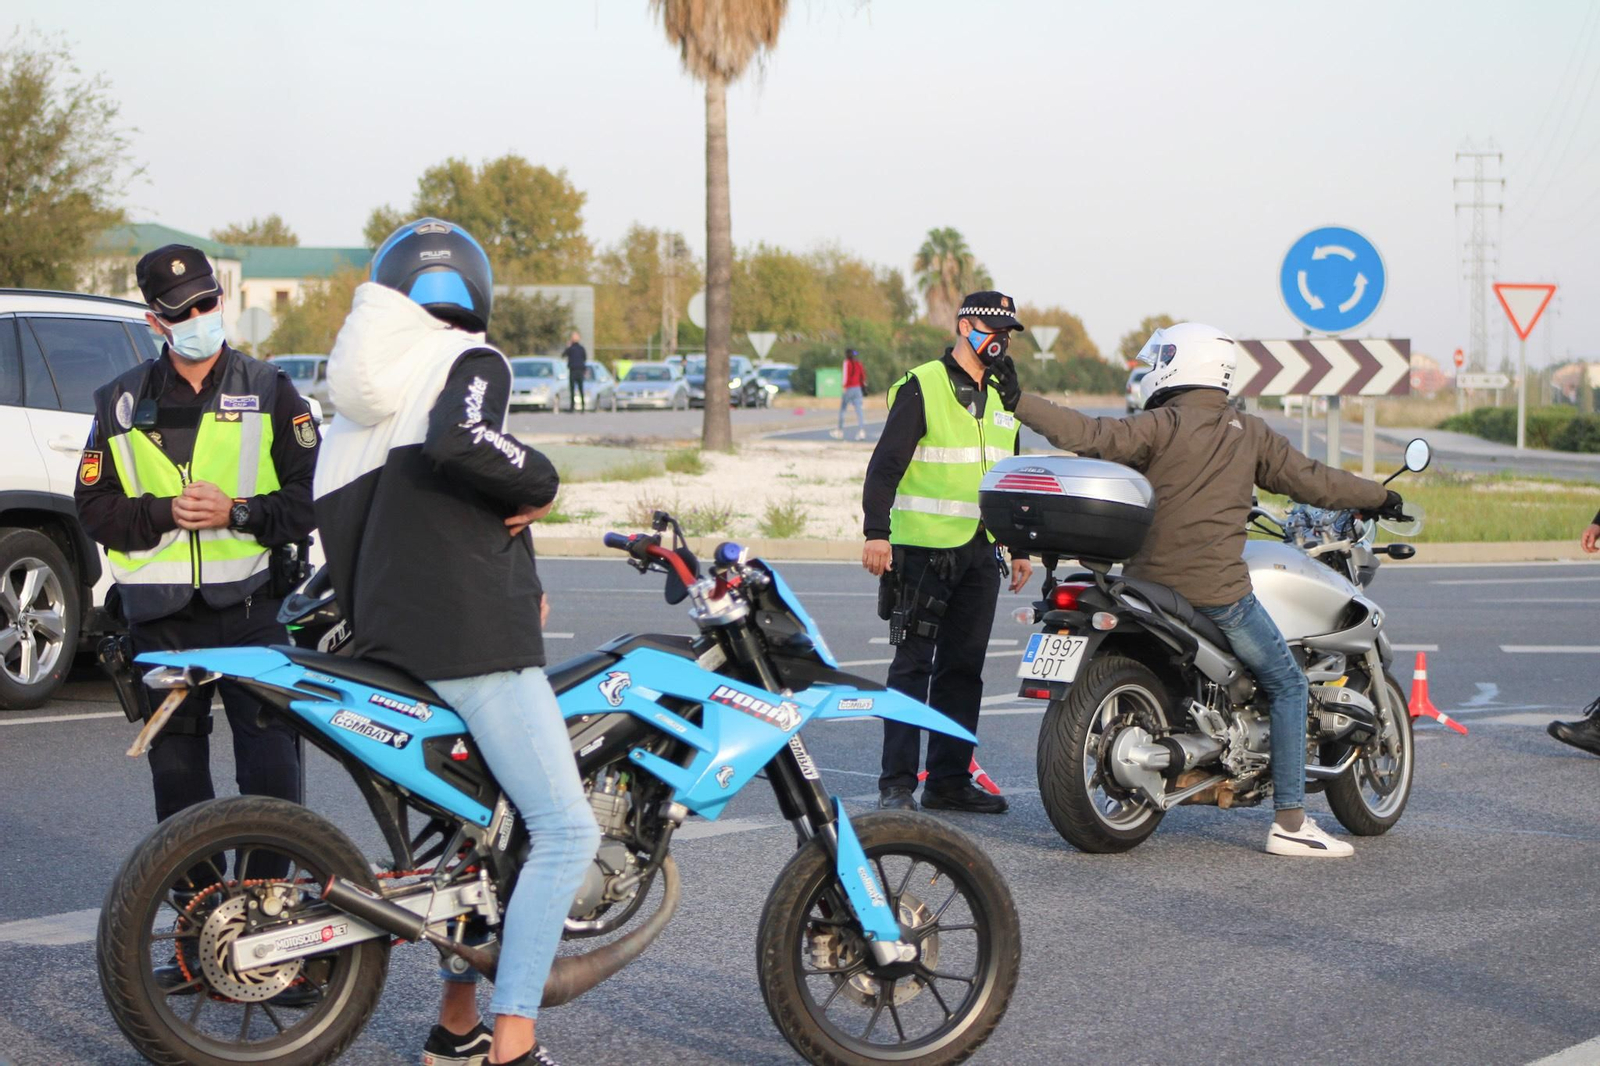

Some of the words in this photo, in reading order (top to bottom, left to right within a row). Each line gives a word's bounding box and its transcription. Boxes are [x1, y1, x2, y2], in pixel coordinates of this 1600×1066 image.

[1041, 638, 1083, 657] 1997
[1031, 657, 1065, 676] CDT
[334, 714, 392, 741] COMBAT
